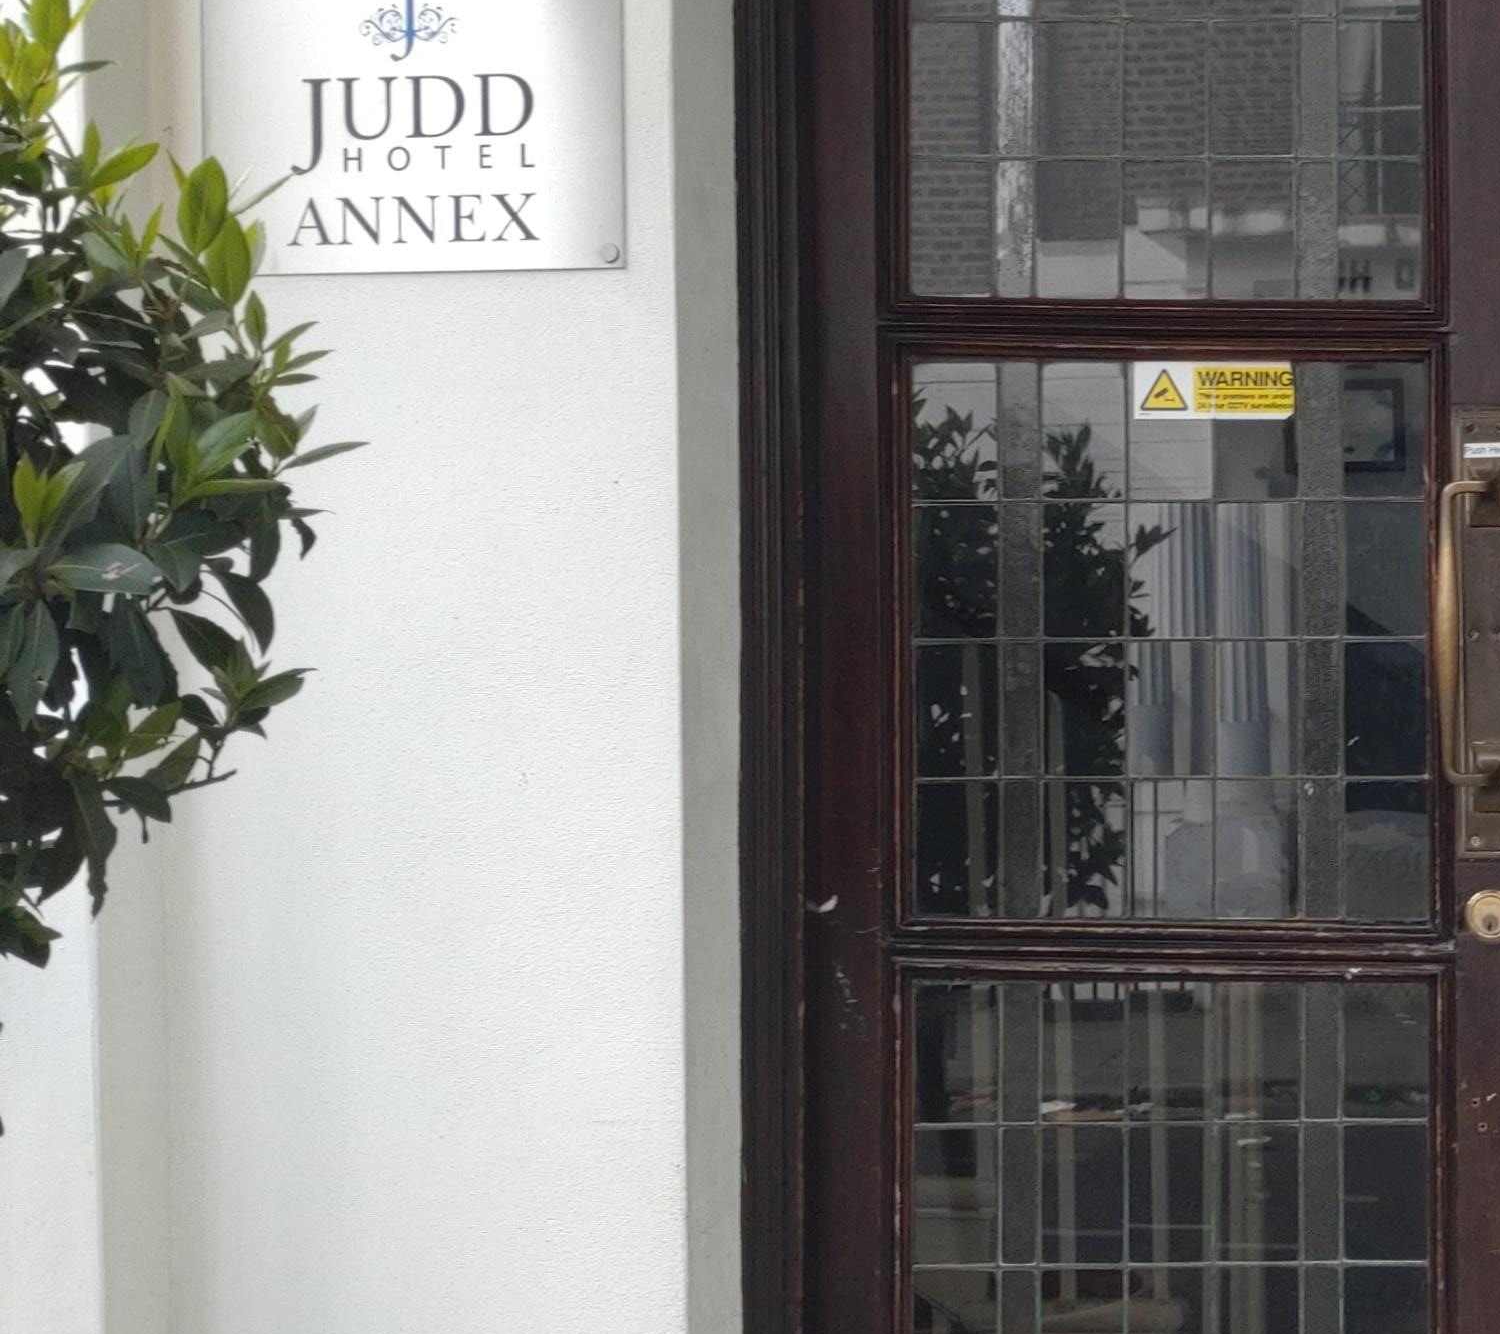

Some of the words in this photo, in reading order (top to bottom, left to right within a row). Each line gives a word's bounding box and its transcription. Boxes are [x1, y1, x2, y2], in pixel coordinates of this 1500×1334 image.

[291, 73, 535, 176] JUDD
[342, 143, 536, 173] HOTEL
[286, 192, 541, 247] ANNEX
[1198, 371, 1294, 387] WARNING
